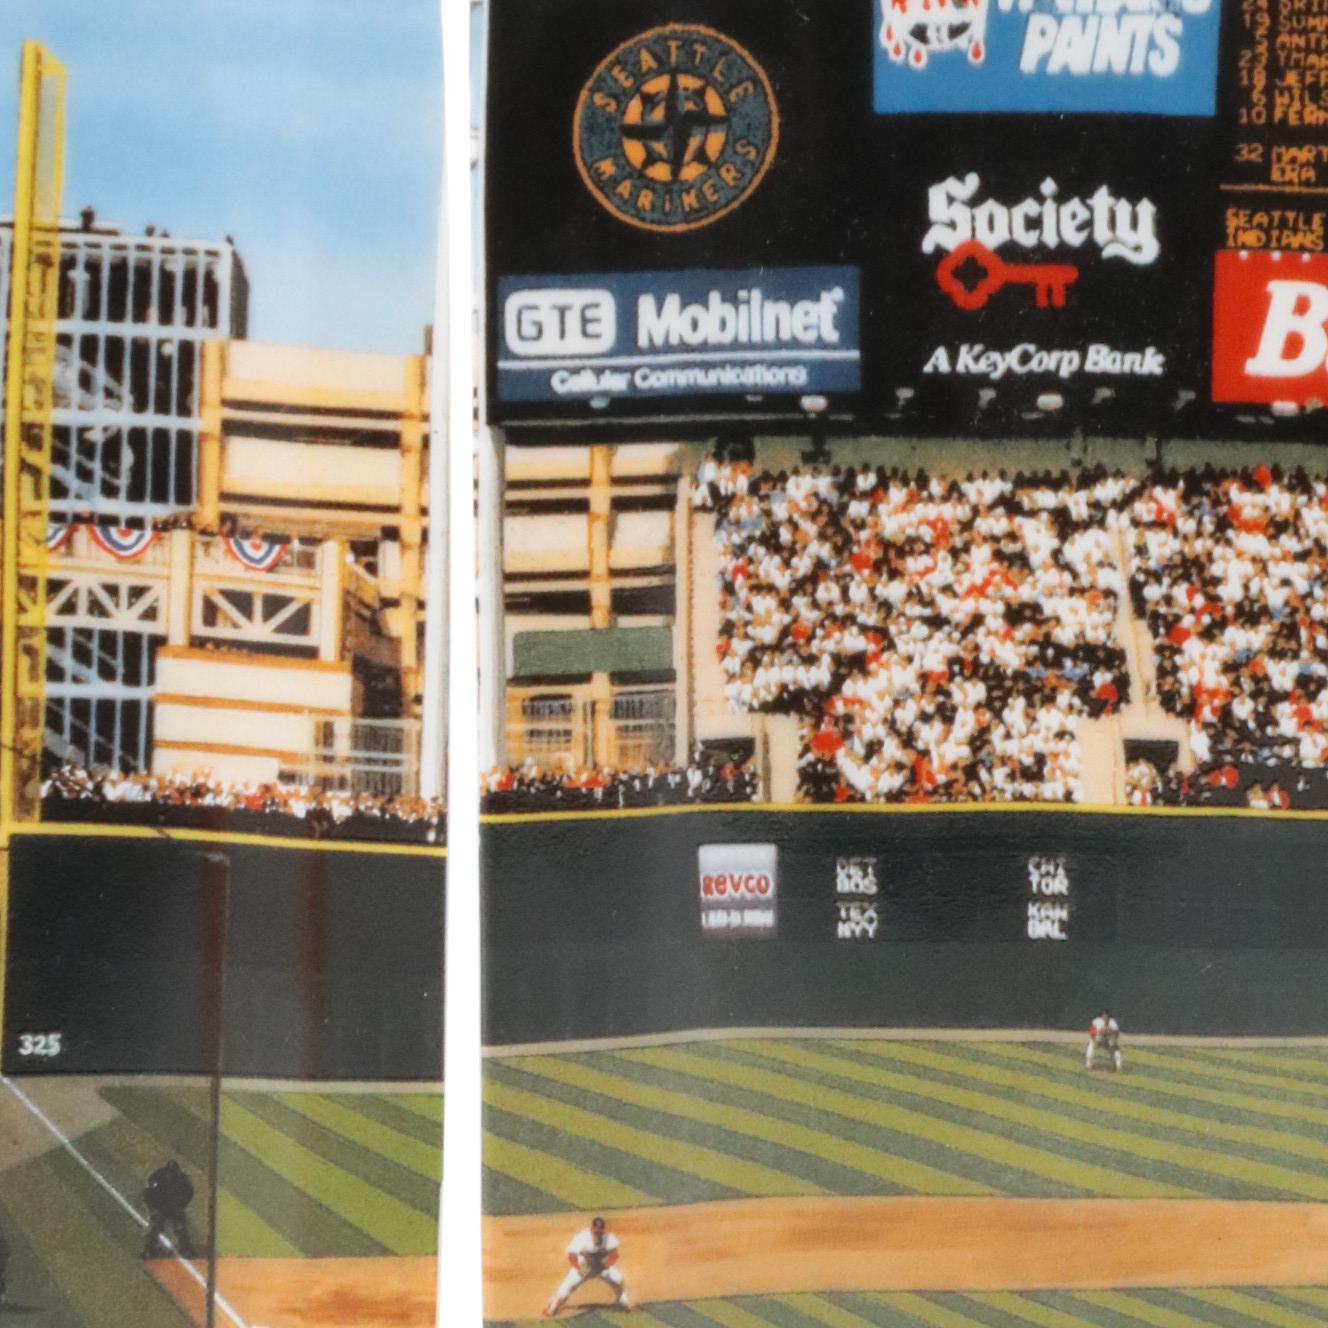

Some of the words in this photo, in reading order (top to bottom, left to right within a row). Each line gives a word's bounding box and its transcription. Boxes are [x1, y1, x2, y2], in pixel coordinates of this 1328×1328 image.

[1019, 11, 1184, 77] PAINTS
[592, 39, 754, 105] SEATTLE
[592, 142, 758, 213] MARINERS
[921, 171, 1162, 265] Society
[1225, 207, 1326, 229] SEATTLE
[1225, 226, 1325, 251] INDIANS
[516, 302, 602, 343] GTE
[636, 286, 840, 349] Mobilnet
[550, 368, 631, 394] Cellular
[633, 363, 808, 390] Communications
[922, 345, 952, 374] A
[955, 342, 1082, 380] KeyCorp
[1084, 343, 1166, 376] Bank
[17, 1033, 61, 1057] 325
